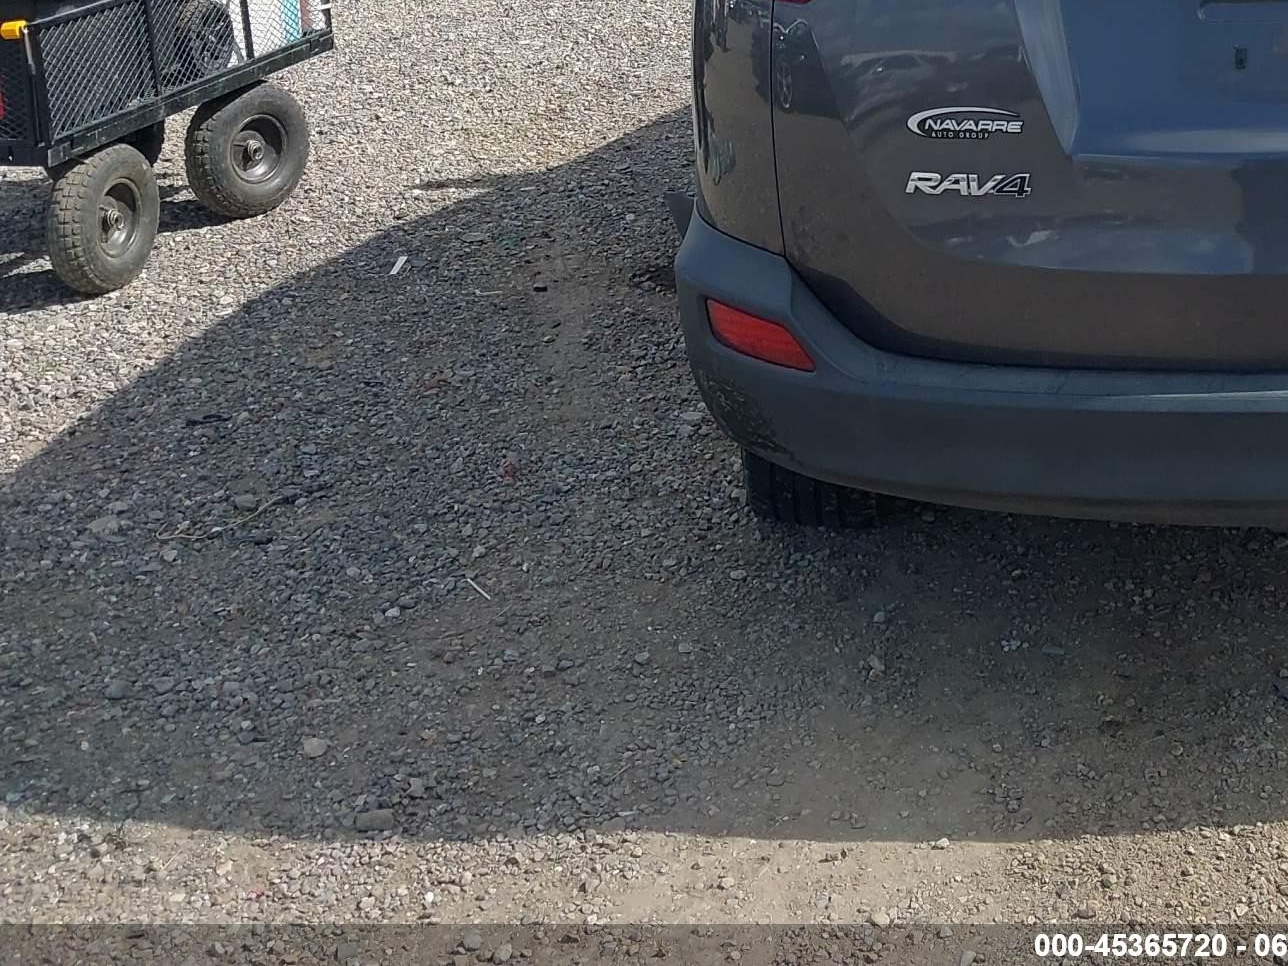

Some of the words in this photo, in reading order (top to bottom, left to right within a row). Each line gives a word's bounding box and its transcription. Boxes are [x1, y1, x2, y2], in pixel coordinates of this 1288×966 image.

[924, 118, 1024, 133] NAVARRE
[959, 131, 990, 139] GROUP
[905, 171, 1032, 198] RAV4
